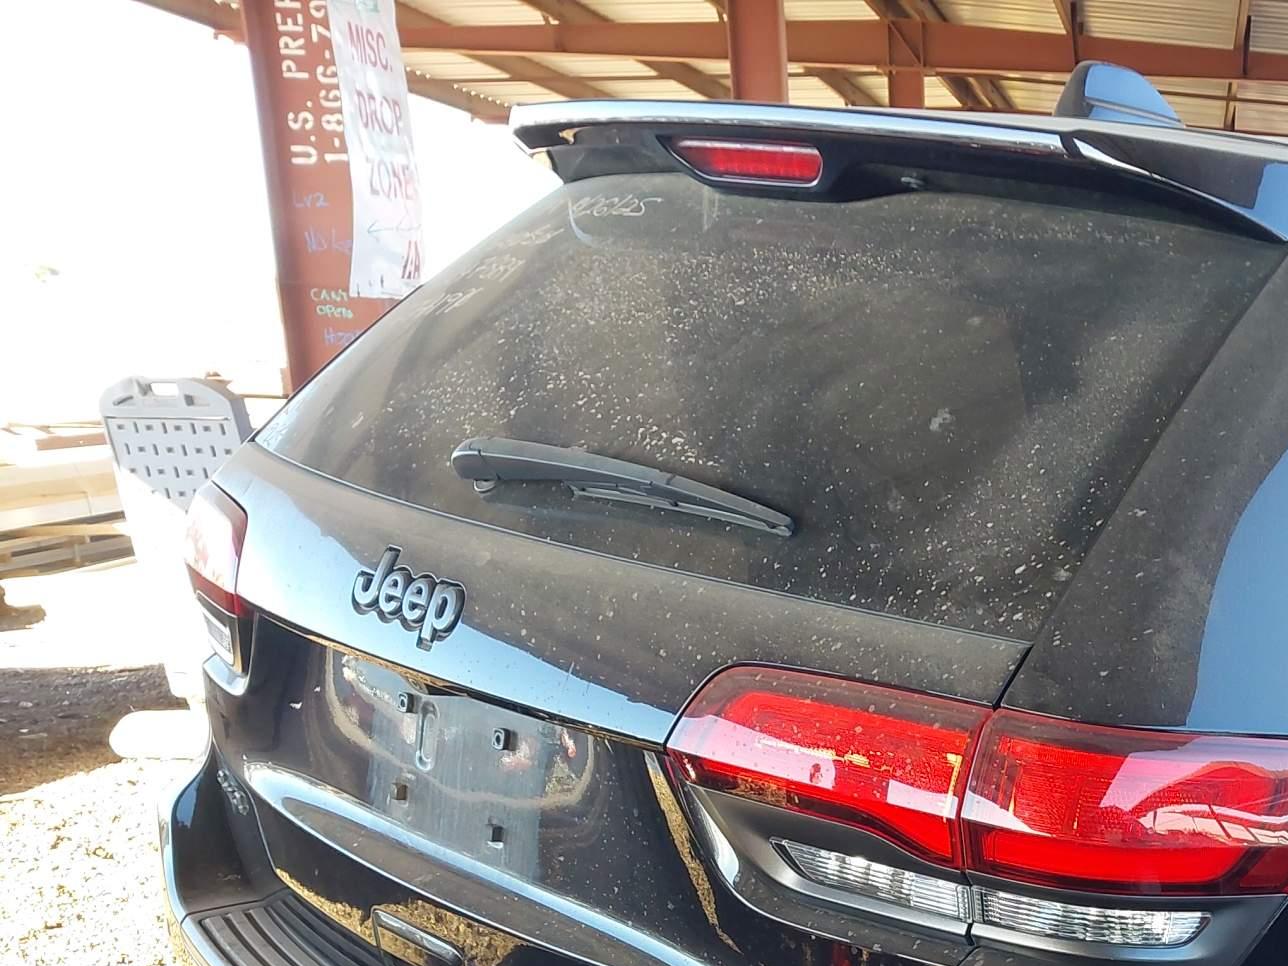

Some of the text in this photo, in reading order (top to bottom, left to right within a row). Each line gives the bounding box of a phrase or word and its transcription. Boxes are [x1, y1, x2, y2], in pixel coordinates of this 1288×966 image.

[346, 21, 393, 72] MISC.
[288, 101, 318, 165] U.S.
[355, 88, 402, 136] DROP
[366, 156, 413, 201] ZONE
[352, 544, 466, 651] Jeep
